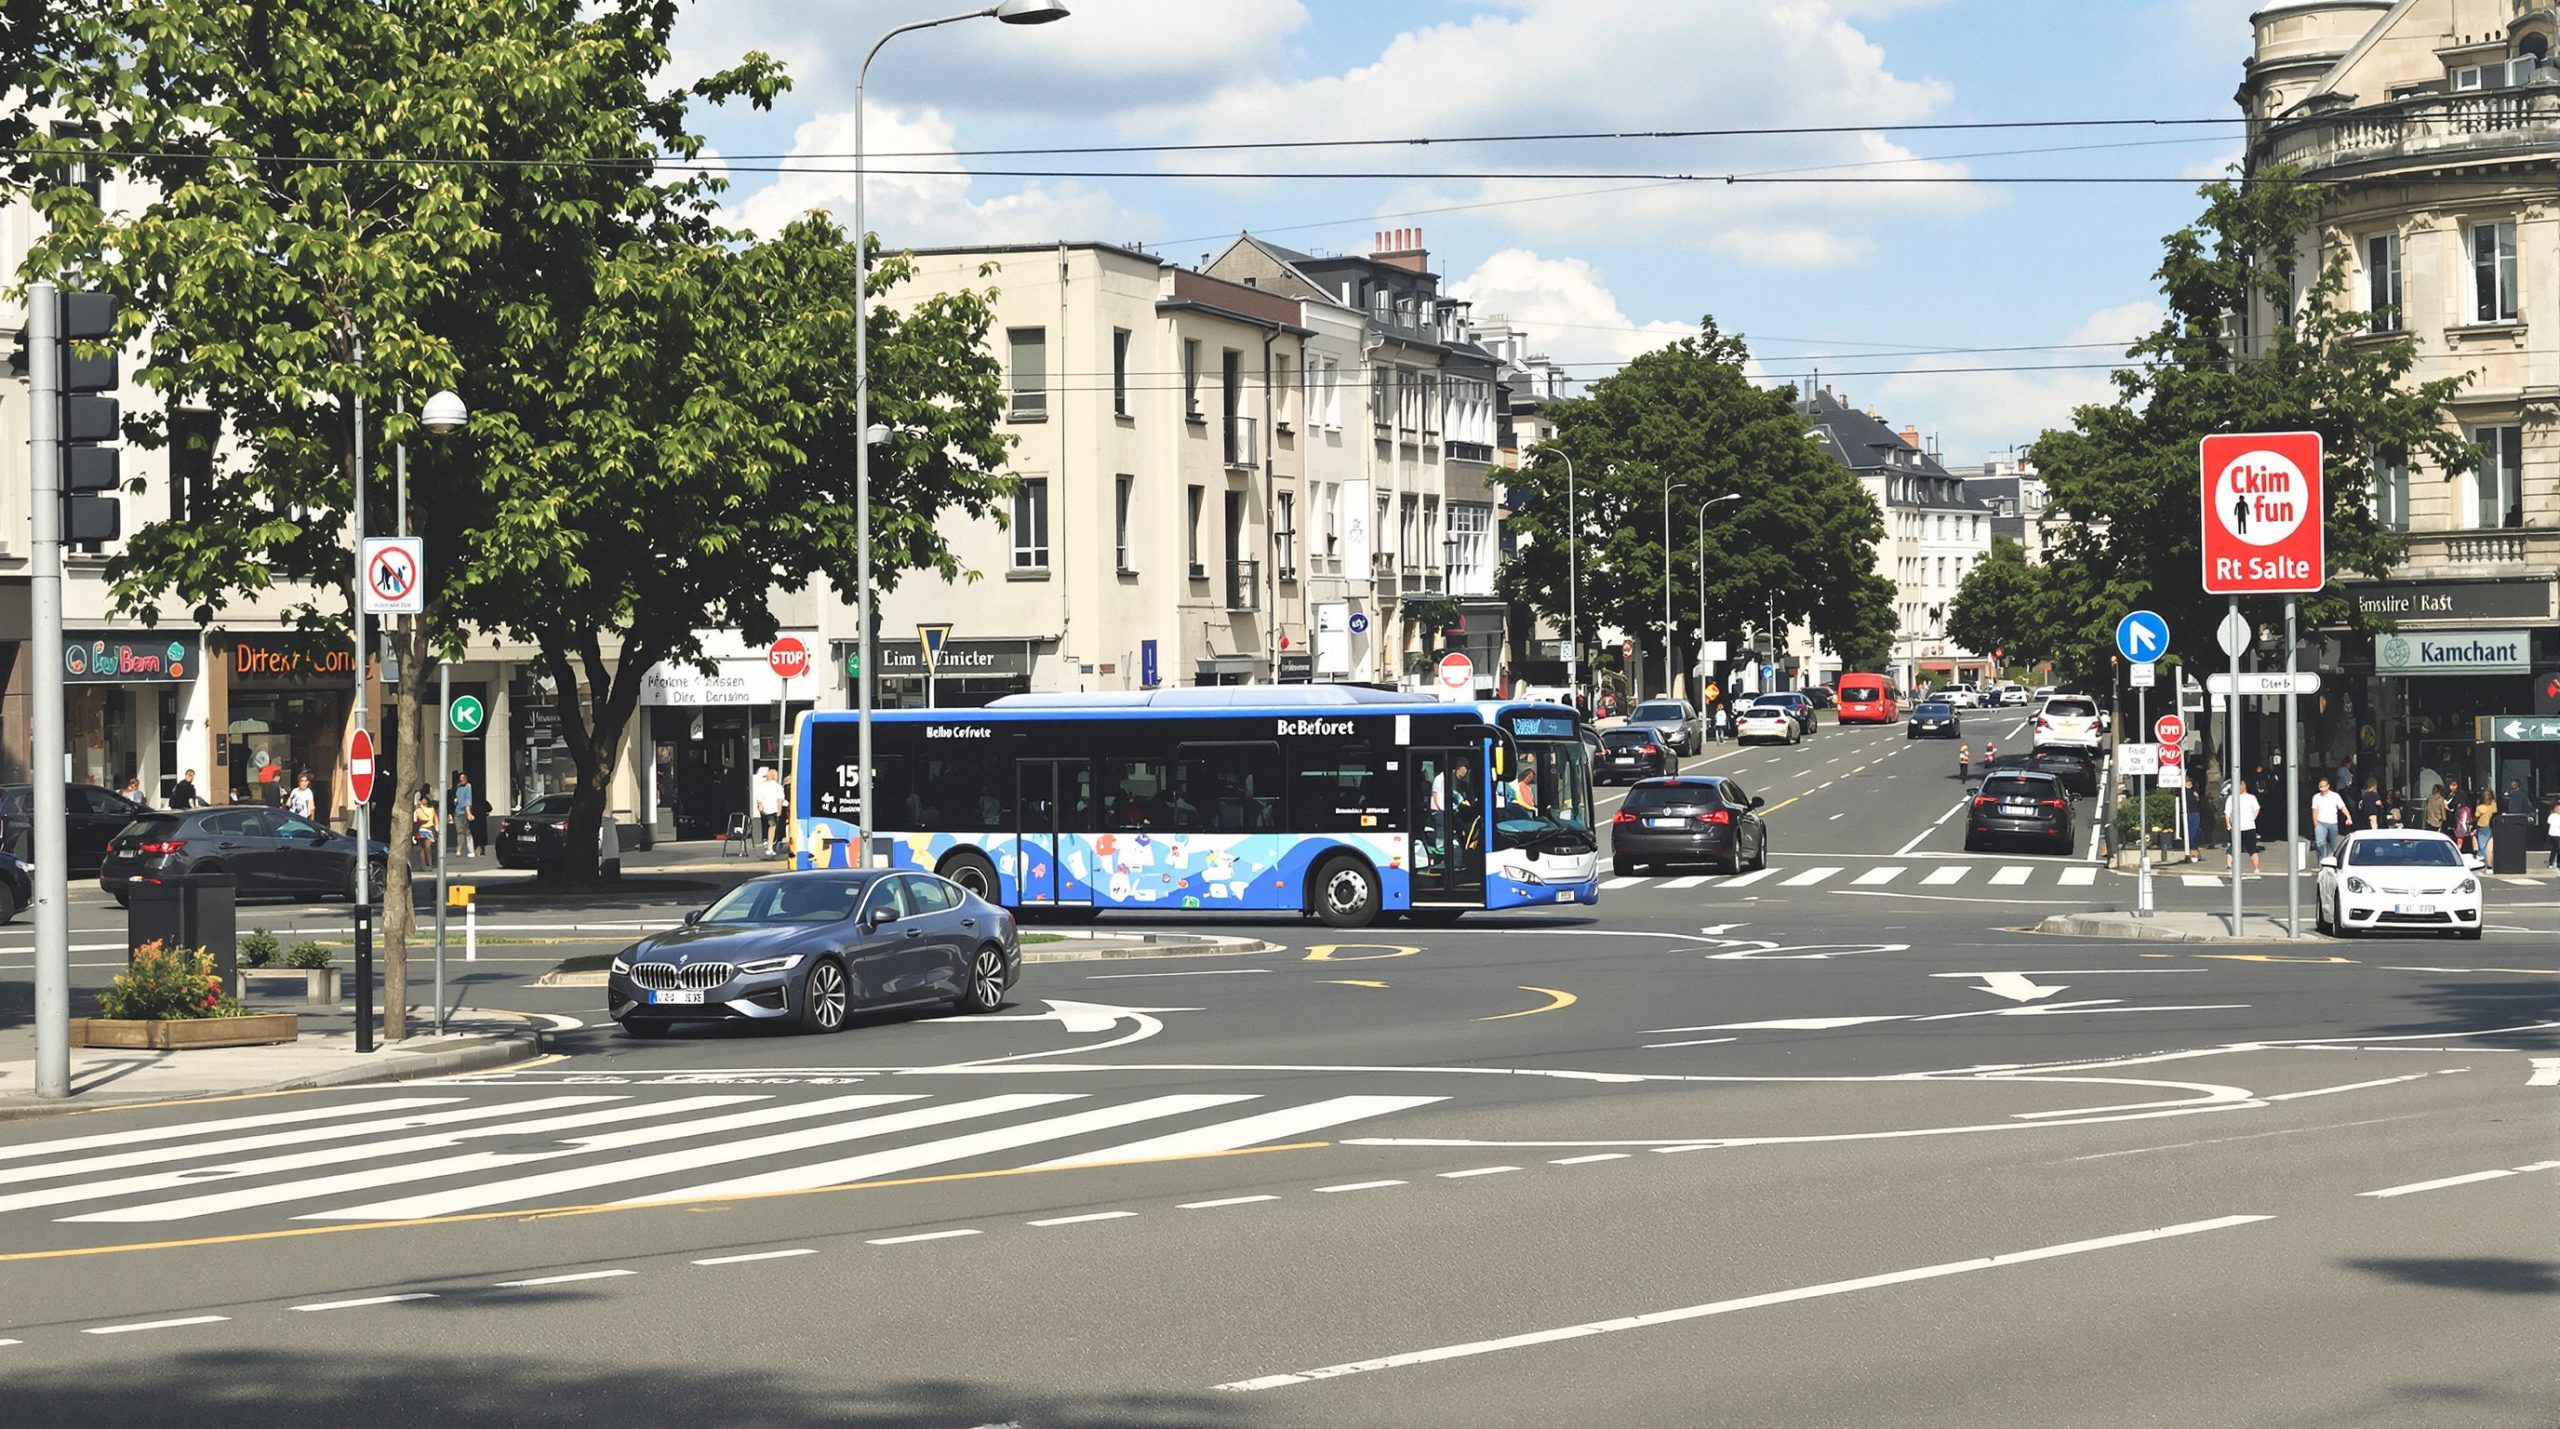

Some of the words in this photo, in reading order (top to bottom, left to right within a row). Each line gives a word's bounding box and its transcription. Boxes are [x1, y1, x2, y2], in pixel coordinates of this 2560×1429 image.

[2231, 465, 2290, 494] Ckim
[2254, 495, 2293, 523] fun
[2216, 557, 2243, 581] Rt
[2248, 555, 2311, 580] Salte
[771, 650, 804, 666] STOP
[2420, 640, 2518, 663] Kamchant
[457, 706, 479, 726] K
